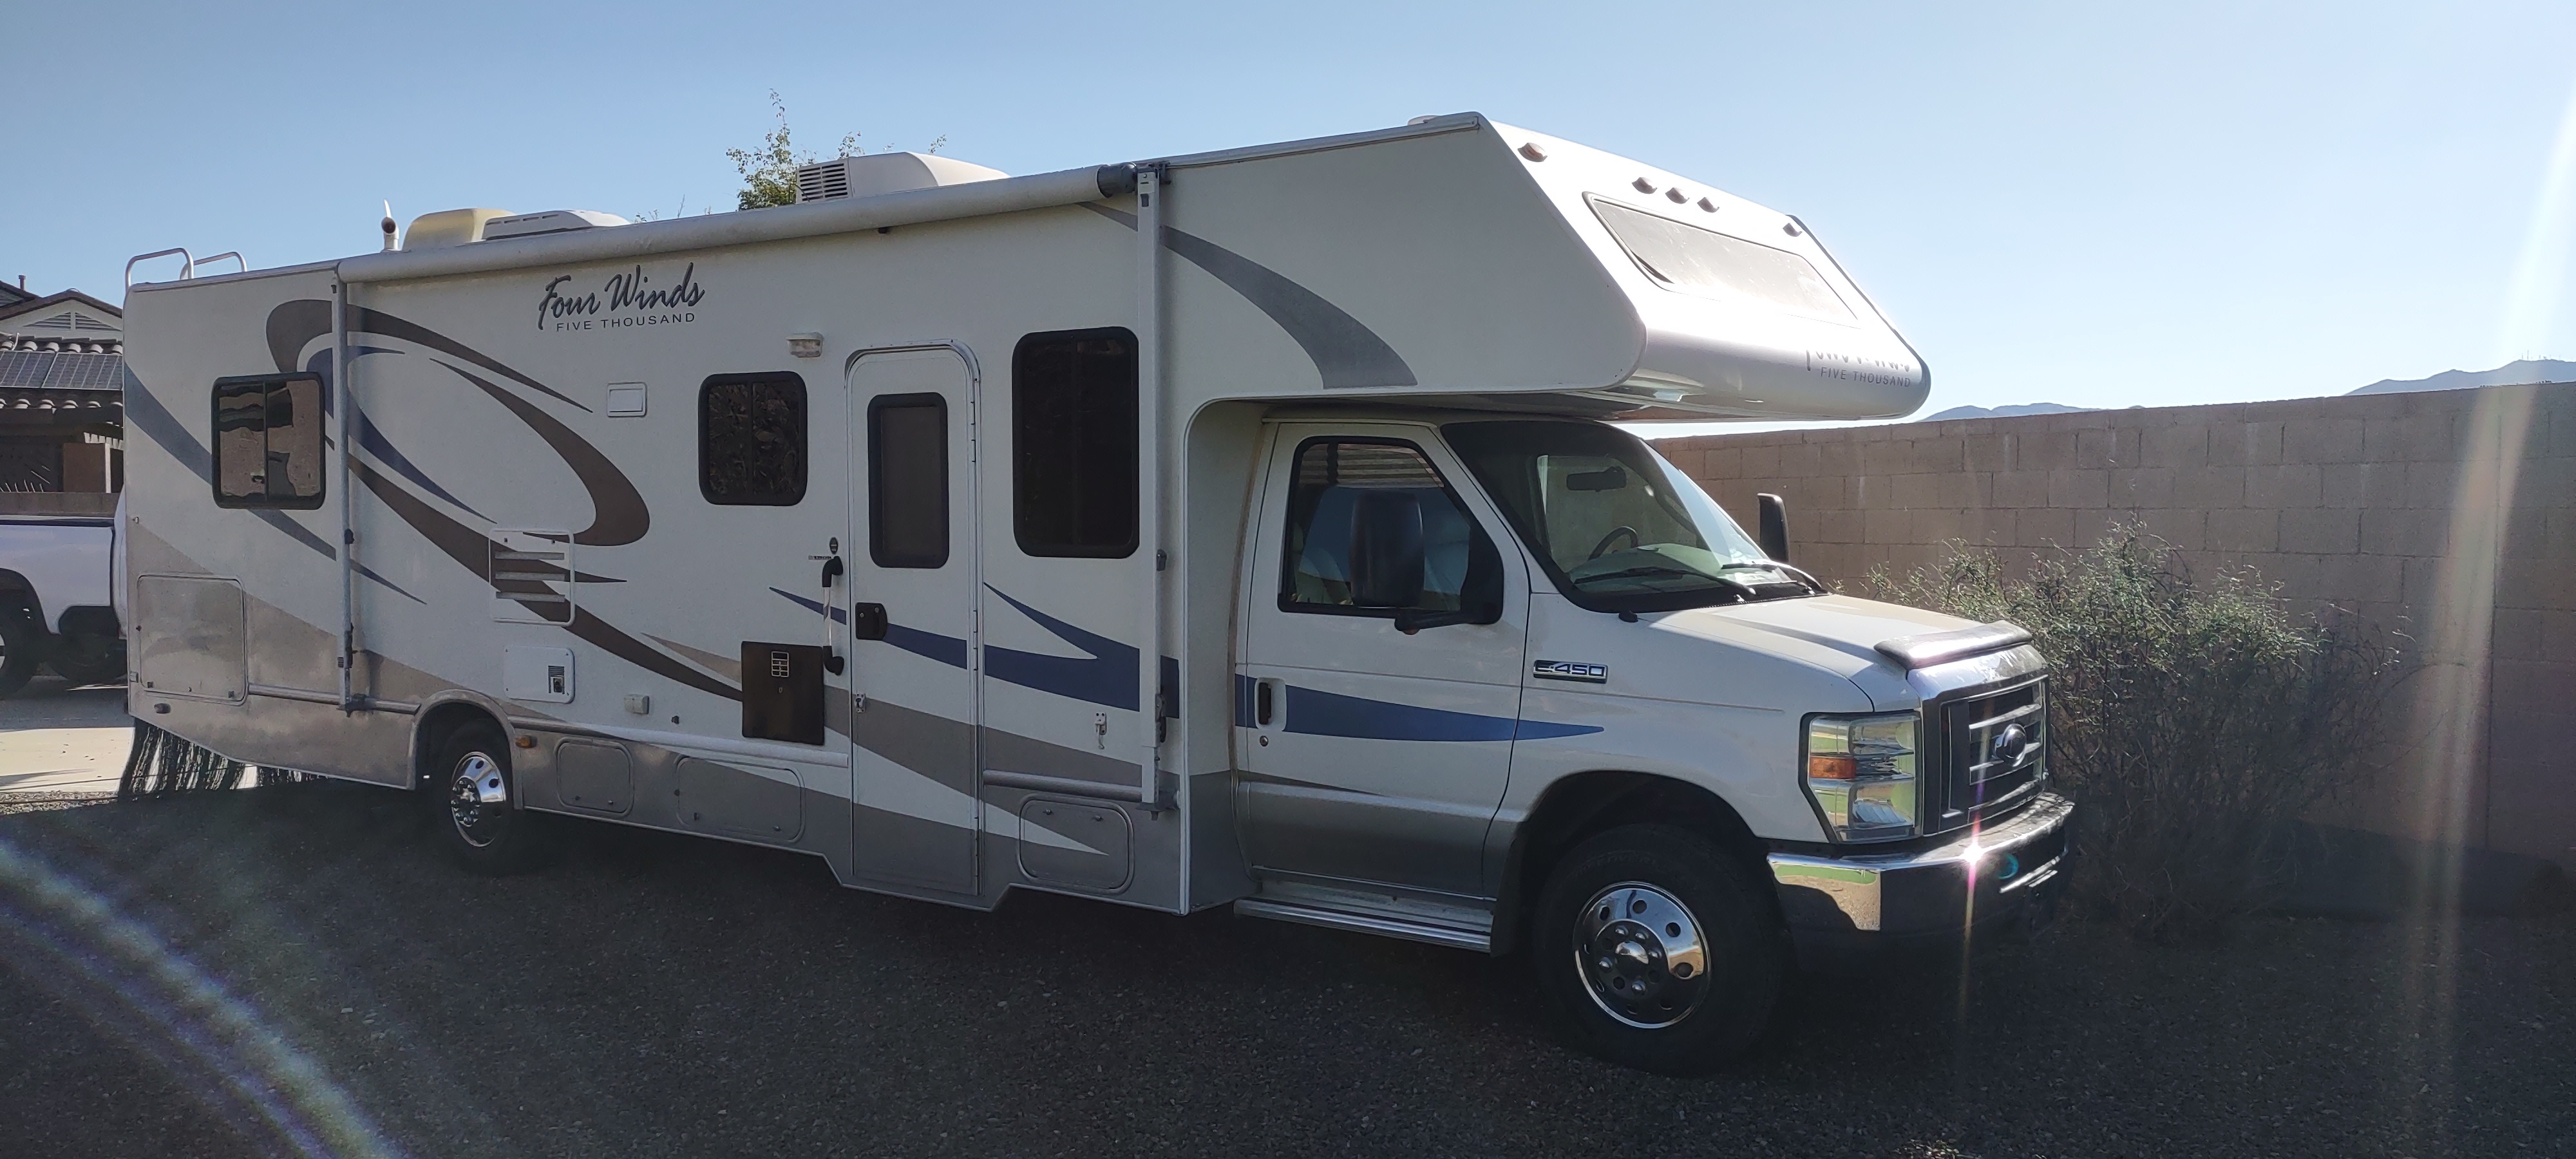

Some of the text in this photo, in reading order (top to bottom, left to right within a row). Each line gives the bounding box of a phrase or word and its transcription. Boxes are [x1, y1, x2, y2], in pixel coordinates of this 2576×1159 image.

[538, 262, 705, 330] Four Winds
[556, 313, 695, 332] FIVE THOUSAND
[1821, 366, 1911, 387] FIVE THOUSAND
